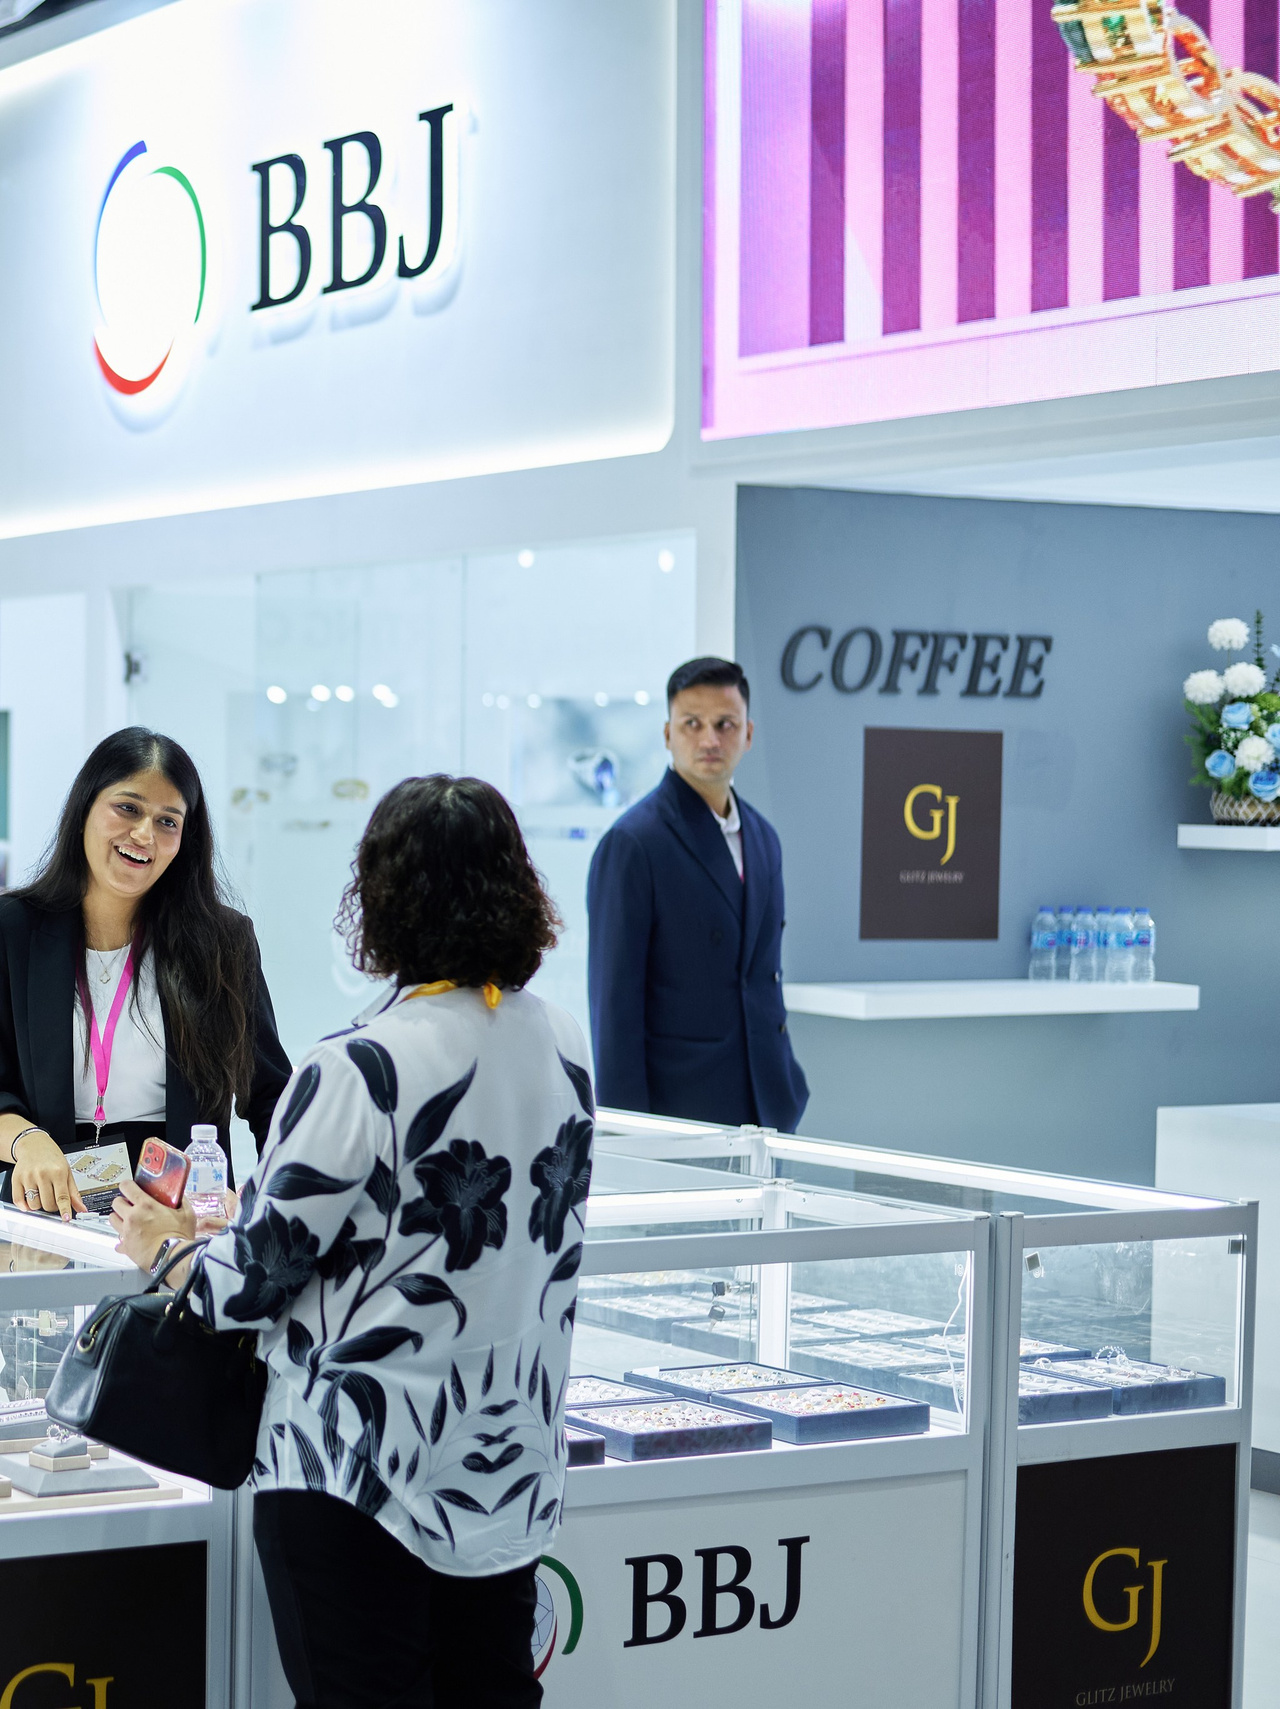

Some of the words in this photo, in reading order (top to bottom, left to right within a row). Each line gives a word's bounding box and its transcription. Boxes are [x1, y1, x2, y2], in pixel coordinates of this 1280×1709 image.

[250, 103, 454, 312] BBJ
[780, 625, 1054, 699] COFFEE
[903, 783, 960, 866] GJ
[623, 1535, 811, 1649] BBJ
[1083, 1547, 1169, 1669] GJ
[1075, 1687, 1116, 1707] GLITZ
[1120, 1678, 1176, 1702] JEWELRY
